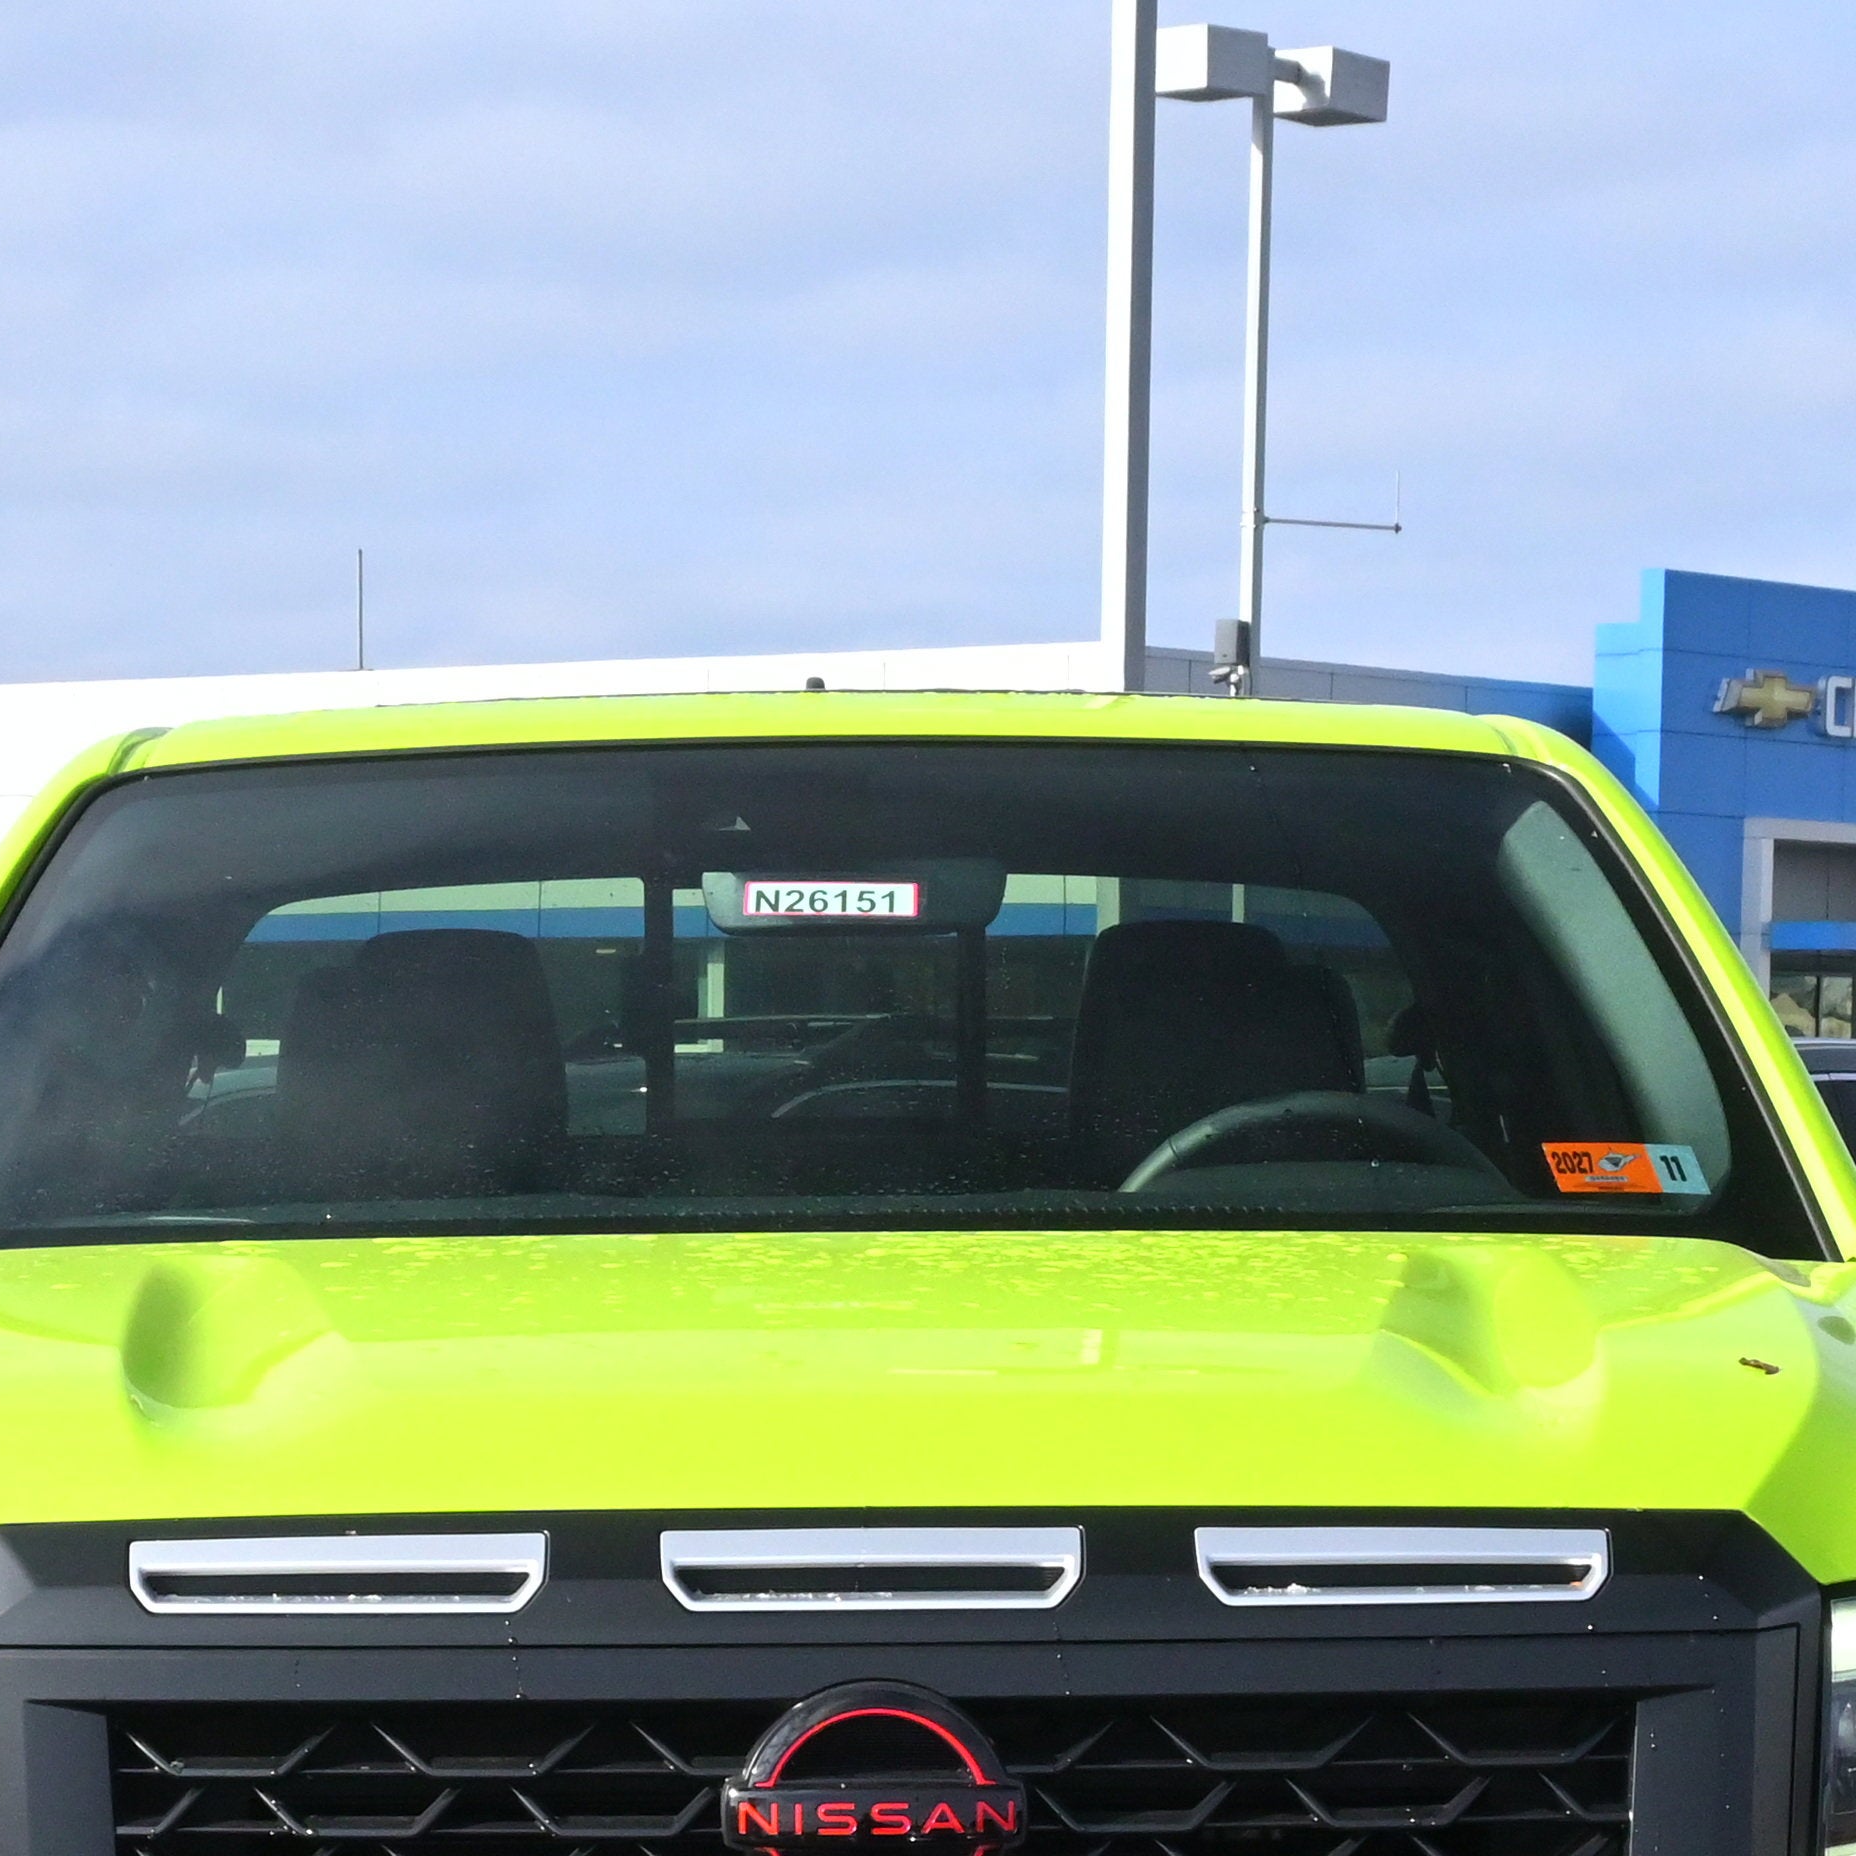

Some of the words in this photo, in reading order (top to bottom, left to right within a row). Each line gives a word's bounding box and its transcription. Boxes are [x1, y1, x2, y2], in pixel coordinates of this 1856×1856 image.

[754, 888, 896, 914] N26151
[1551, 1151, 1594, 1174] 2027
[1659, 1155, 1687, 1182] 11
[738, 1800, 1017, 1835] NISSAN
